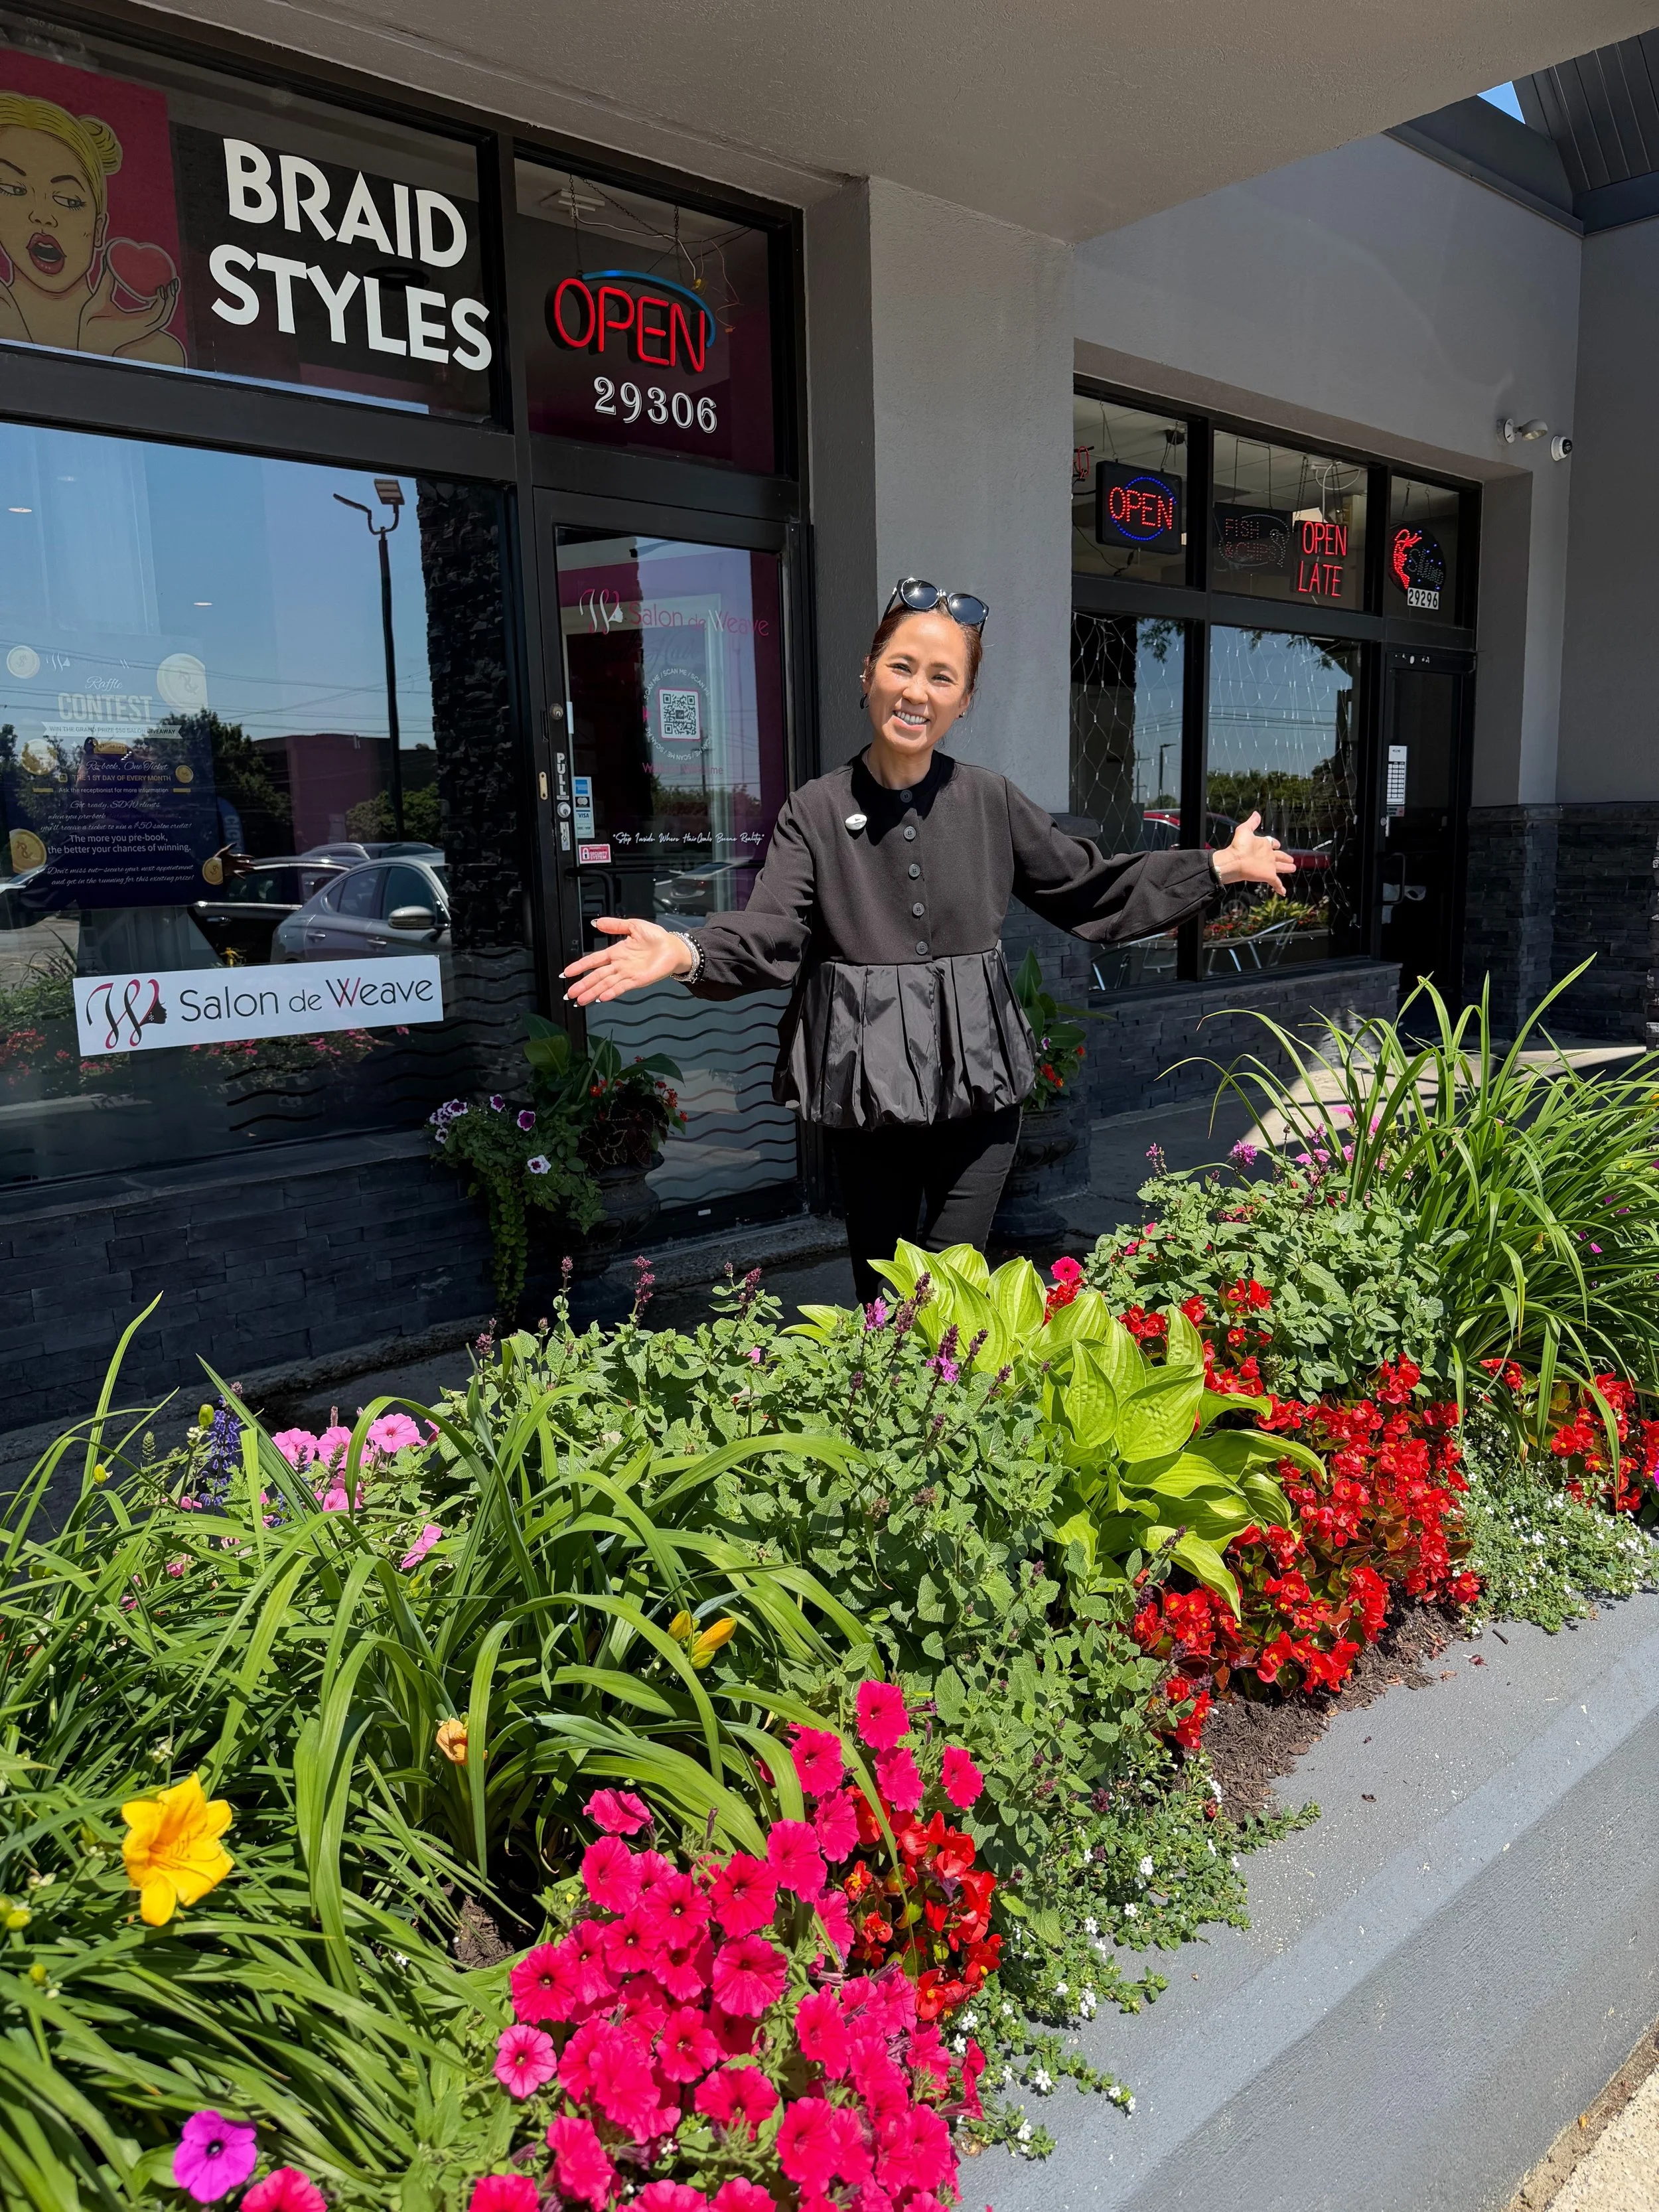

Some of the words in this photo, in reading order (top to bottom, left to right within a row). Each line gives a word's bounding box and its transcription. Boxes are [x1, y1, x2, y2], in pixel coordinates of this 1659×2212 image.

[223, 138, 468, 267] BRAID
[209, 244, 492, 371] STYLES
[553, 277, 705, 372] OPEN
[594, 376, 717, 433] 29306
[1109, 486, 1173, 530] OPEN
[1225, 518, 1260, 538] FISH
[1302, 521, 1347, 556] OPEN
[1298, 560, 1343, 597] LATE
[1408, 589, 1438, 609] 29296
[630, 602, 683, 628] Salon
[707, 609, 769, 636] Weave
[85, 676, 123, 691] Raffle
[663, 668, 678, 677] SCAN
[690, 674, 705, 688] SCAN
[58, 692, 153, 722] CONTEST
[124, 761, 142, 770] One
[556, 752, 567, 796] PULL
[64, 845, 91, 853] better
[157, 844, 191, 852] winning.
[69, 834, 86, 843] The
[129, 833, 168, 844] pre-book,
[156, 864, 194, 873] appointment
[180, 986, 279, 1022] Salon
[289, 989, 323, 1013] de
[325, 977, 434, 1009] Weave
